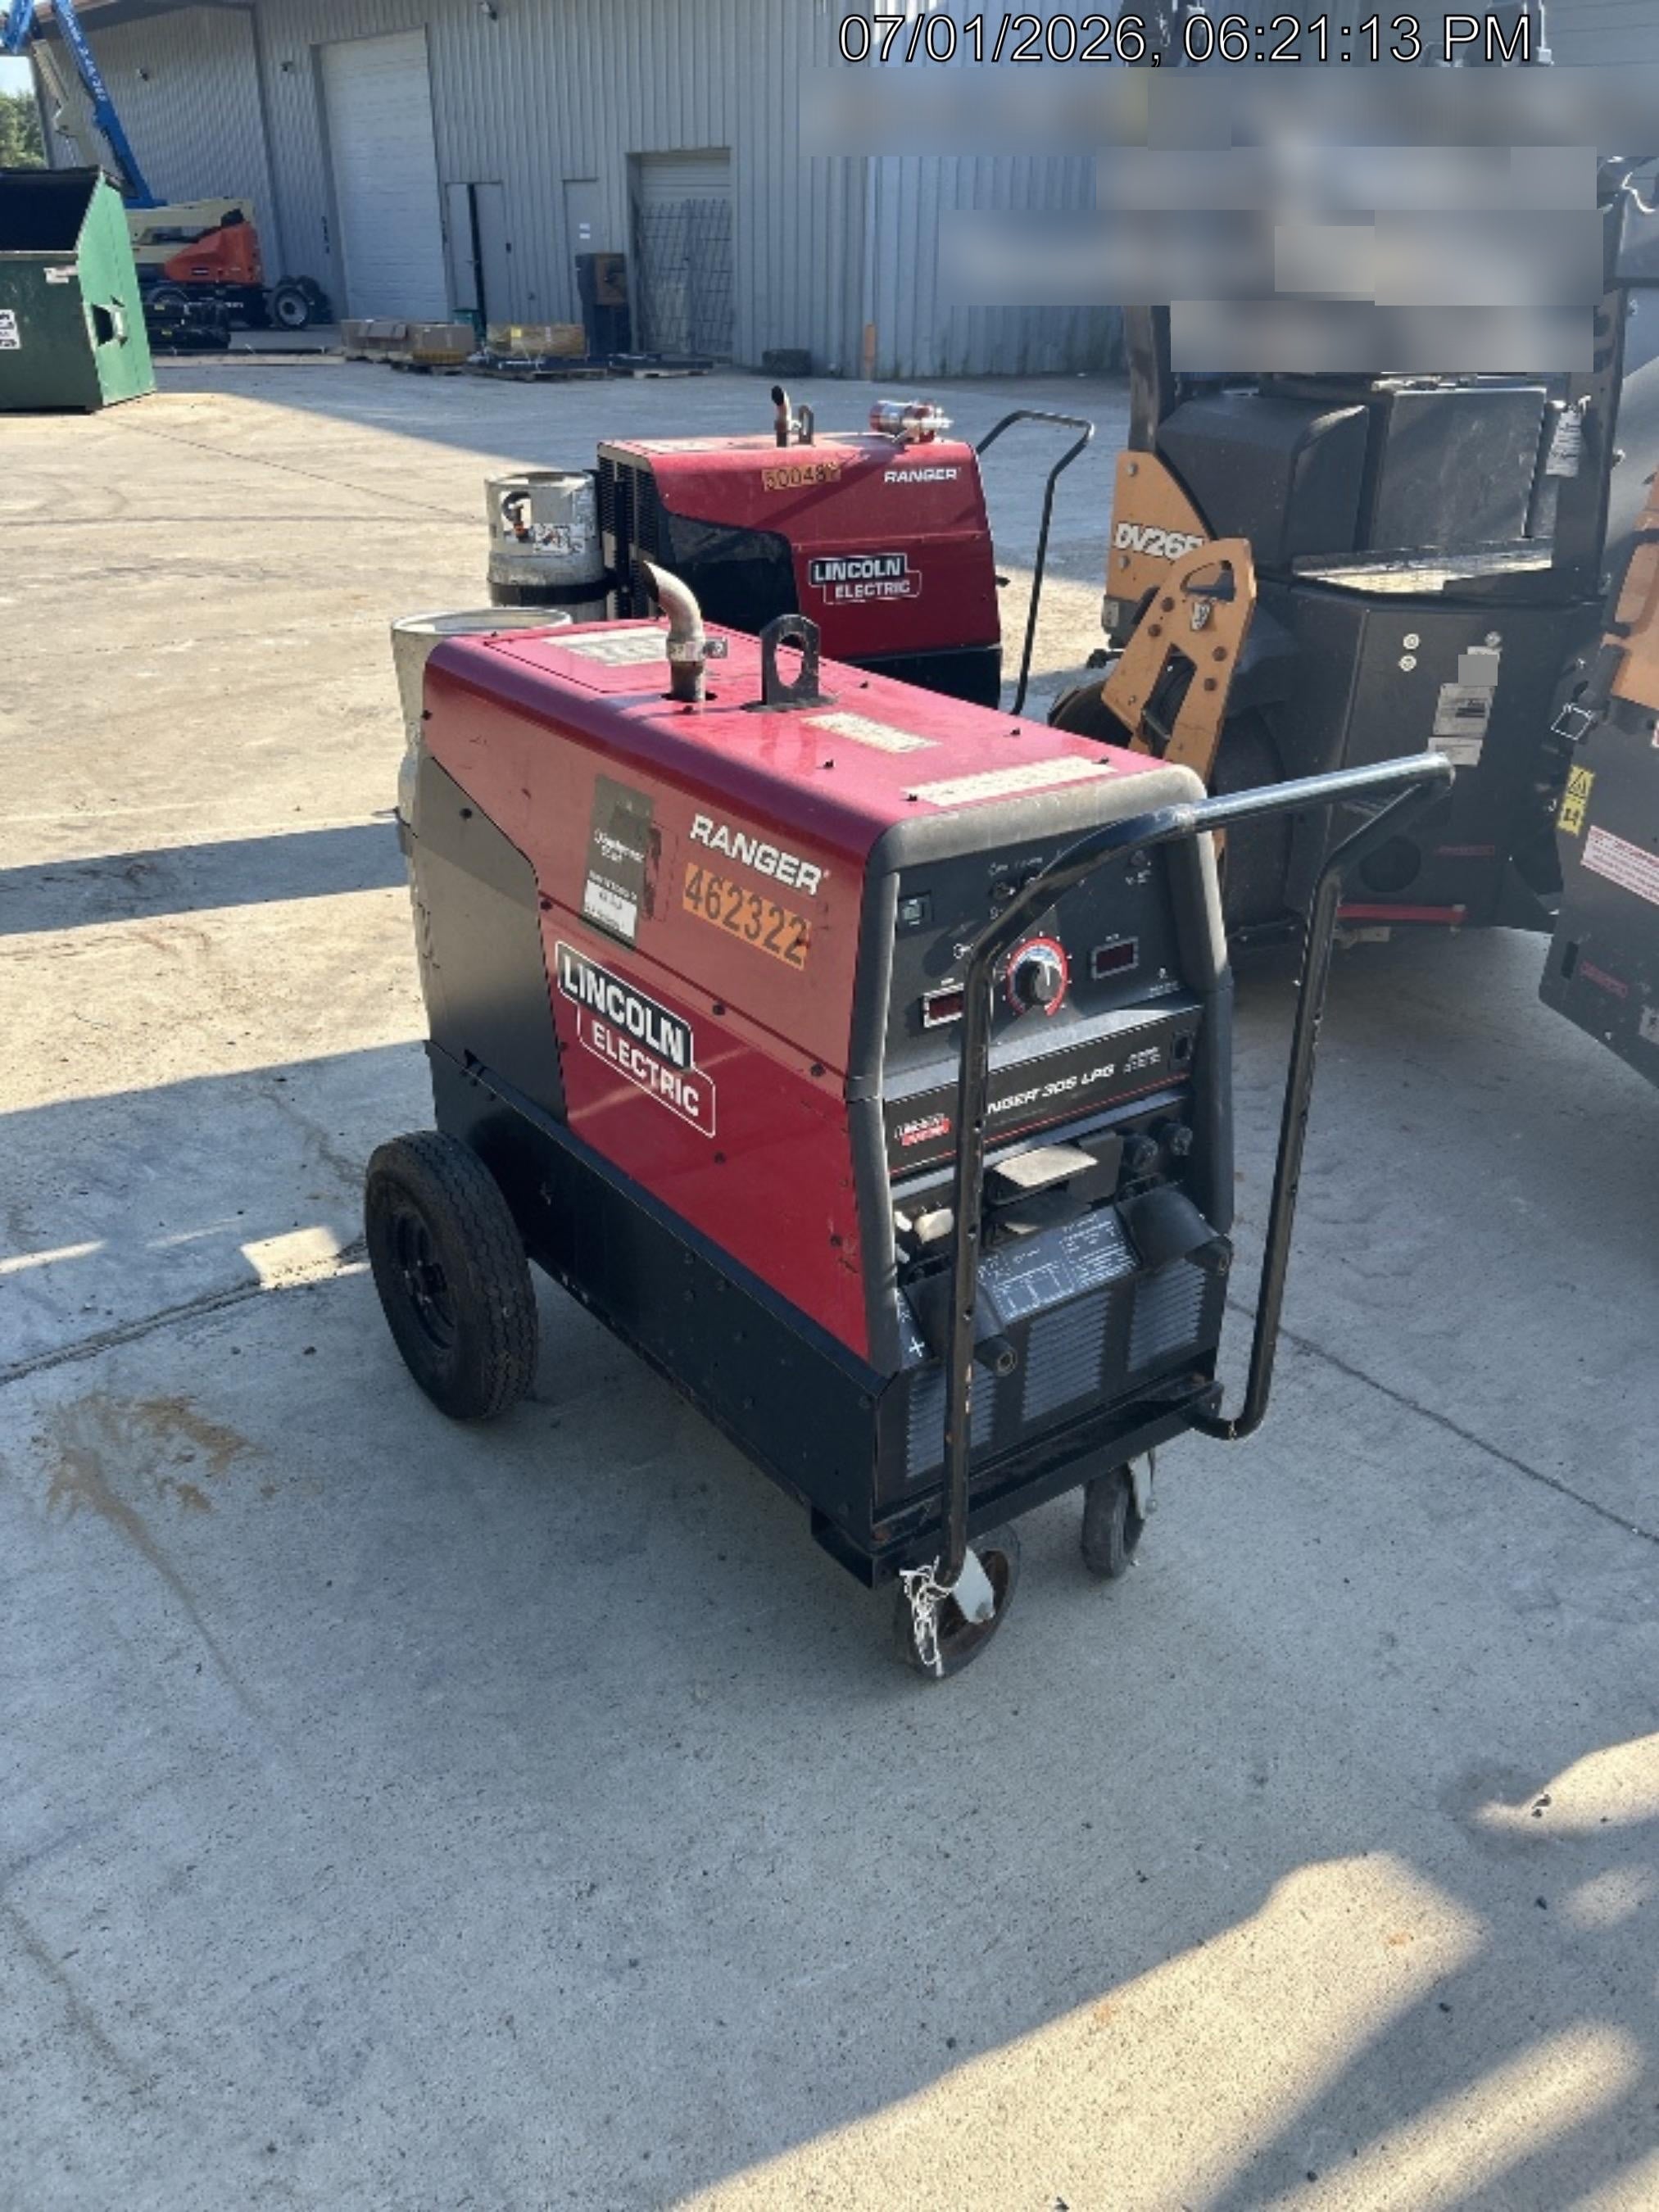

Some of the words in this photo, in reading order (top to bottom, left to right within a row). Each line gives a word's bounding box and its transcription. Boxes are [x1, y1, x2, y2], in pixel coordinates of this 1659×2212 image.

[884, 467, 958, 483] RANGER
[814, 557, 900, 582] LINCOLN
[834, 580, 911, 600] ELECTRIC
[690, 812, 823, 896] RANGER
[684, 867, 808, 965] 462322
[563, 954, 685, 1067] LINCOLN
[592, 1021, 700, 1117] ELECTRIC
